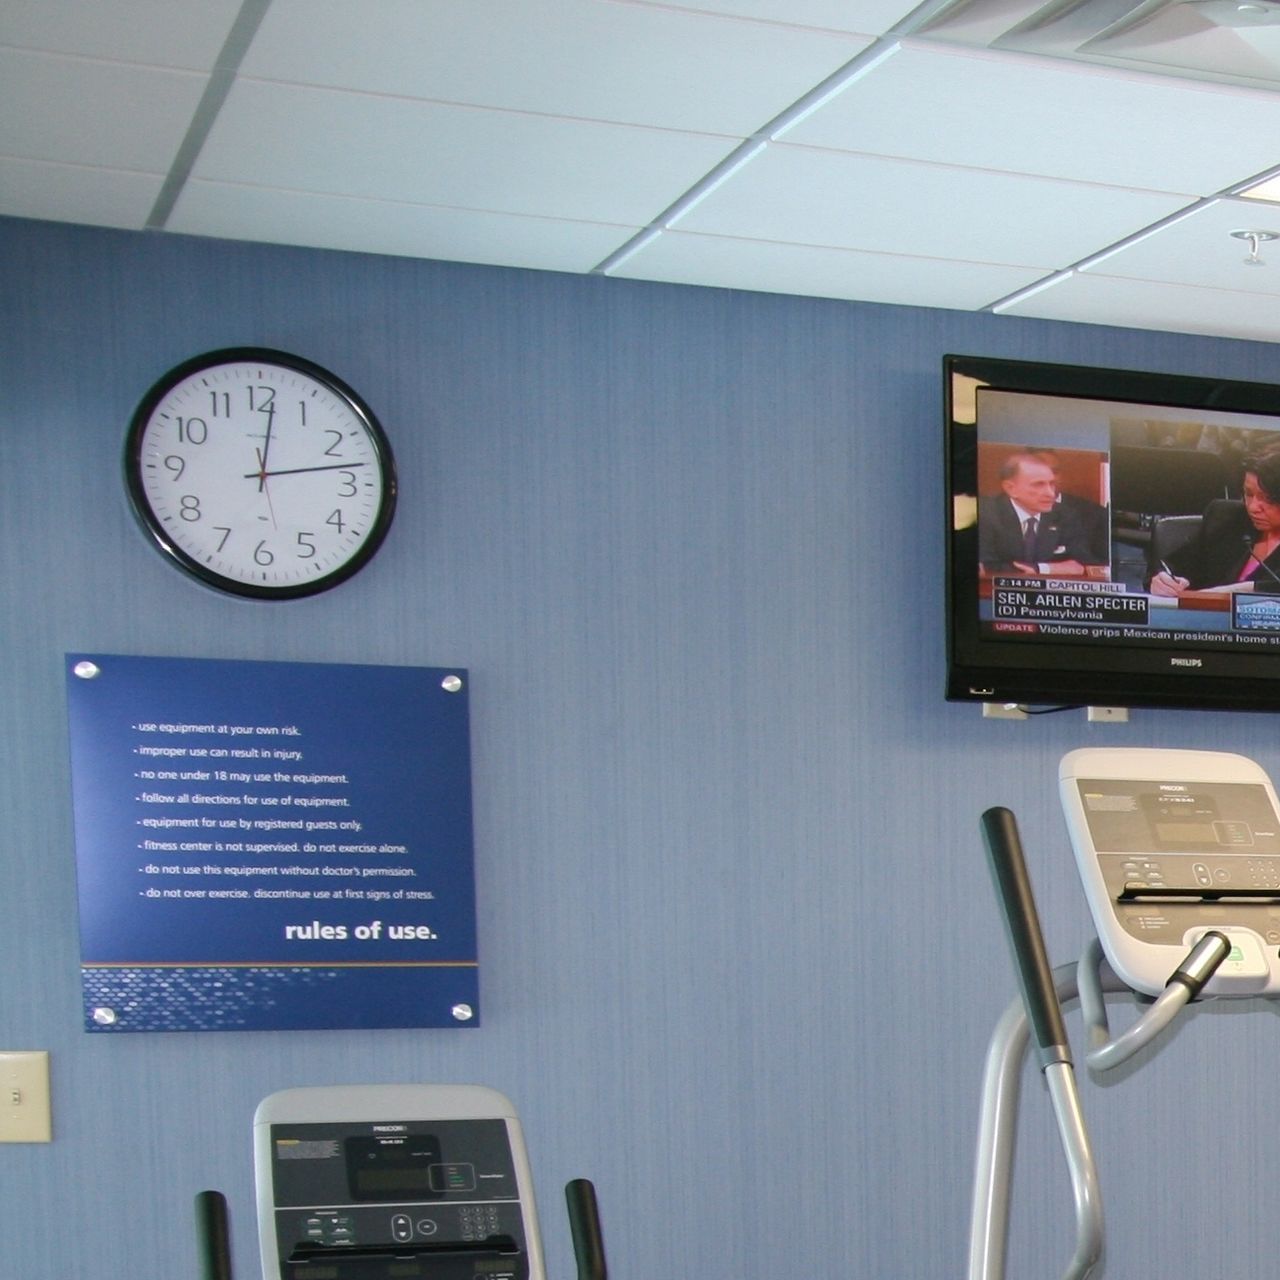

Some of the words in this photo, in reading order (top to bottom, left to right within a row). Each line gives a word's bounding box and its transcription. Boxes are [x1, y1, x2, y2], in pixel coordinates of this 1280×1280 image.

[210, 391, 231, 418] 11
[246, 386, 276, 414] 12
[299, 400, 307, 427] 1
[176, 416, 208, 445] 10
[324, 430, 342, 457] 2
[164, 455, 186, 482] 9
[337, 471, 358, 498] 3
[180, 496, 201, 522] 8
[326, 508, 346, 534] 4
[212, 527, 232, 552] 7
[297, 532, 316, 558] 5
[253, 540, 274, 566] 6
[999, 579, 1022, 587] 2:14
[1025, 580, 1041, 588] PM
[1048, 581, 1095, 592] CAPITOL
[1099, 583, 1123, 593] HILL
[998, 592, 1031, 606] SEN.
[1035, 595, 1082, 608] ARLEN
[1086, 597, 1146, 611] SPECTER
[998, 605, 1017, 616] (D)
[1020, 607, 1104, 620] Pennsylvania
[995, 624, 1034, 632] UPDATE
[1039, 624, 1088, 635] Violence
[1092, 628, 1120, 639] grips
[1124, 628, 1171, 640] Mexican
[1174, 632, 1233, 642] president's
[1236, 634, 1268, 644] home
[1171, 658, 1202, 667] PHILIPS
[138, 723, 157, 732] use
[159, 723, 215, 734] equipment
[217, 725, 228, 734] at
[230, 726, 253, 736] your
[256, 726, 279, 735] own
[282, 726, 302, 736] risk.
[139, 745, 186, 758] improper
[190, 748, 208, 757] use
[210, 749, 228, 758] can
[231, 748, 260, 758] result
[261, 748, 271, 758] in
[274, 748, 303, 761] injury.
[140, 770, 155, 780] no
[158, 772, 178, 780] one
[180, 771, 210, 780] under
[214, 770, 228, 781] 18
[229, 773, 251, 784] may
[254, 773, 272, 782] use
[274, 772, 291, 782] the
[293, 773, 349, 785] equipment.
[142, 792, 174, 803] follow
[176, 793, 190, 804] all
[192, 794, 241, 804] directions
[243, 794, 258, 805] for
[260, 797, 278, 806] use
[280, 795, 292, 806] of
[294, 796, 350, 808] equipment.
[142, 816, 200, 829] equipment
[202, 817, 216, 828] for
[219, 820, 236, 828] use
[239, 818, 252, 830] by
[254, 818, 303, 831] registered
[306, 820, 338, 831] guests
[144, 840, 178, 850] fitness
[180, 841, 212, 852] center
[214, 842, 223, 852] is
[226, 842, 243, 852] not
[246, 842, 300, 854] supervised.
[303, 842, 316, 853] do
[320, 844, 336, 853] not
[338, 843, 378, 854] exercise
[379, 844, 409, 854] alone.
[144, 864, 160, 874] do
[162, 864, 180, 874] not
[182, 866, 200, 874] use
[202, 864, 222, 875] this
[224, 866, 278, 876] equipment
[280, 866, 320, 876] without
[322, 865, 360, 876] doctor's
[362, 866, 416, 878] permission.
[146, 888, 161, 898] do
[163, 888, 182, 898] not
[184, 890, 206, 898] over
[254, 888, 311, 899] discontinue
[313, 890, 330, 899] use
[332, 890, 342, 899] at
[345, 888, 364, 900] first
[366, 890, 390, 902] signs
[392, 889, 404, 900] of
[406, 890, 435, 900] stress.
[286, 920, 348, 940] rules
[354, 920, 382, 940] of
[388, 926, 438, 940] use.
